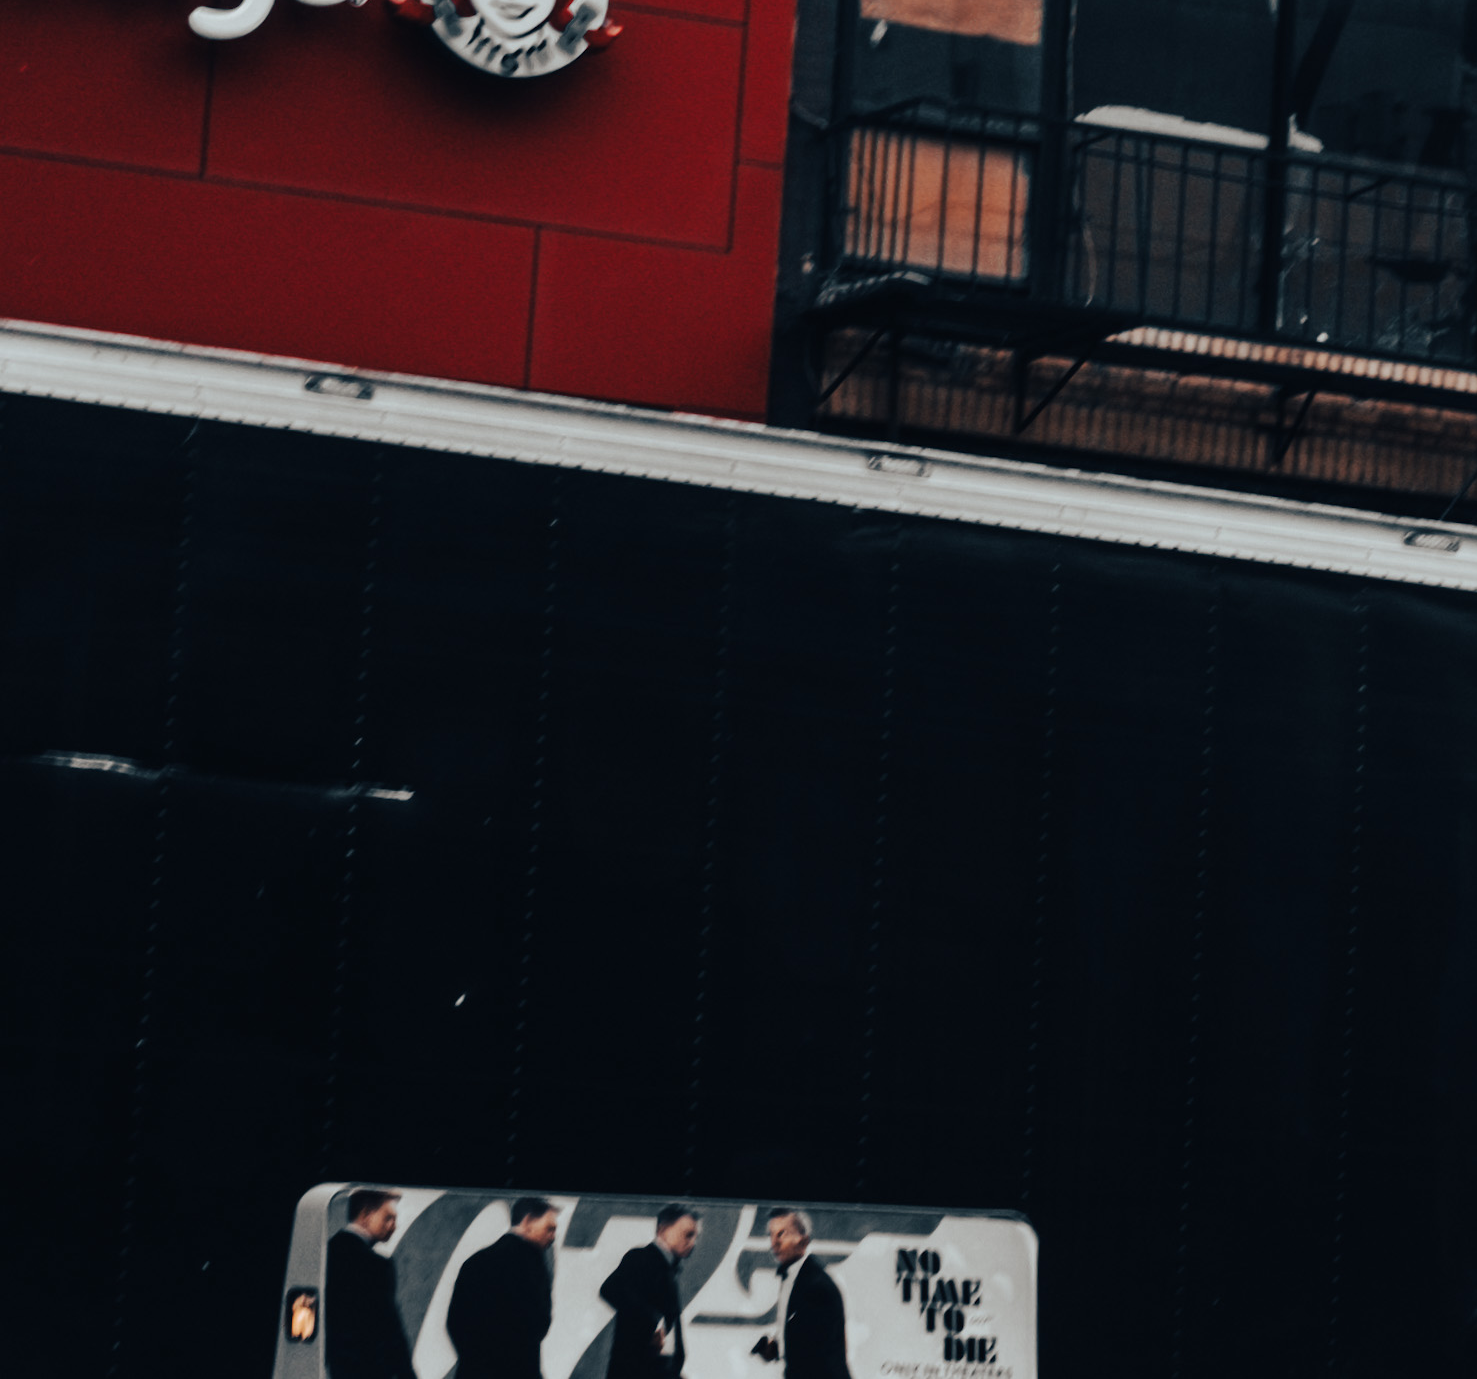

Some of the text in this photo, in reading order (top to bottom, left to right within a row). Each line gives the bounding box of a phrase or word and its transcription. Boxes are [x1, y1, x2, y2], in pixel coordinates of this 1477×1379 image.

[897, 1249, 941, 1275] NO
[896, 1275, 981, 1306] TIME
[920, 1303, 965, 1334] TO
[944, 1337, 997, 1364] DIE
